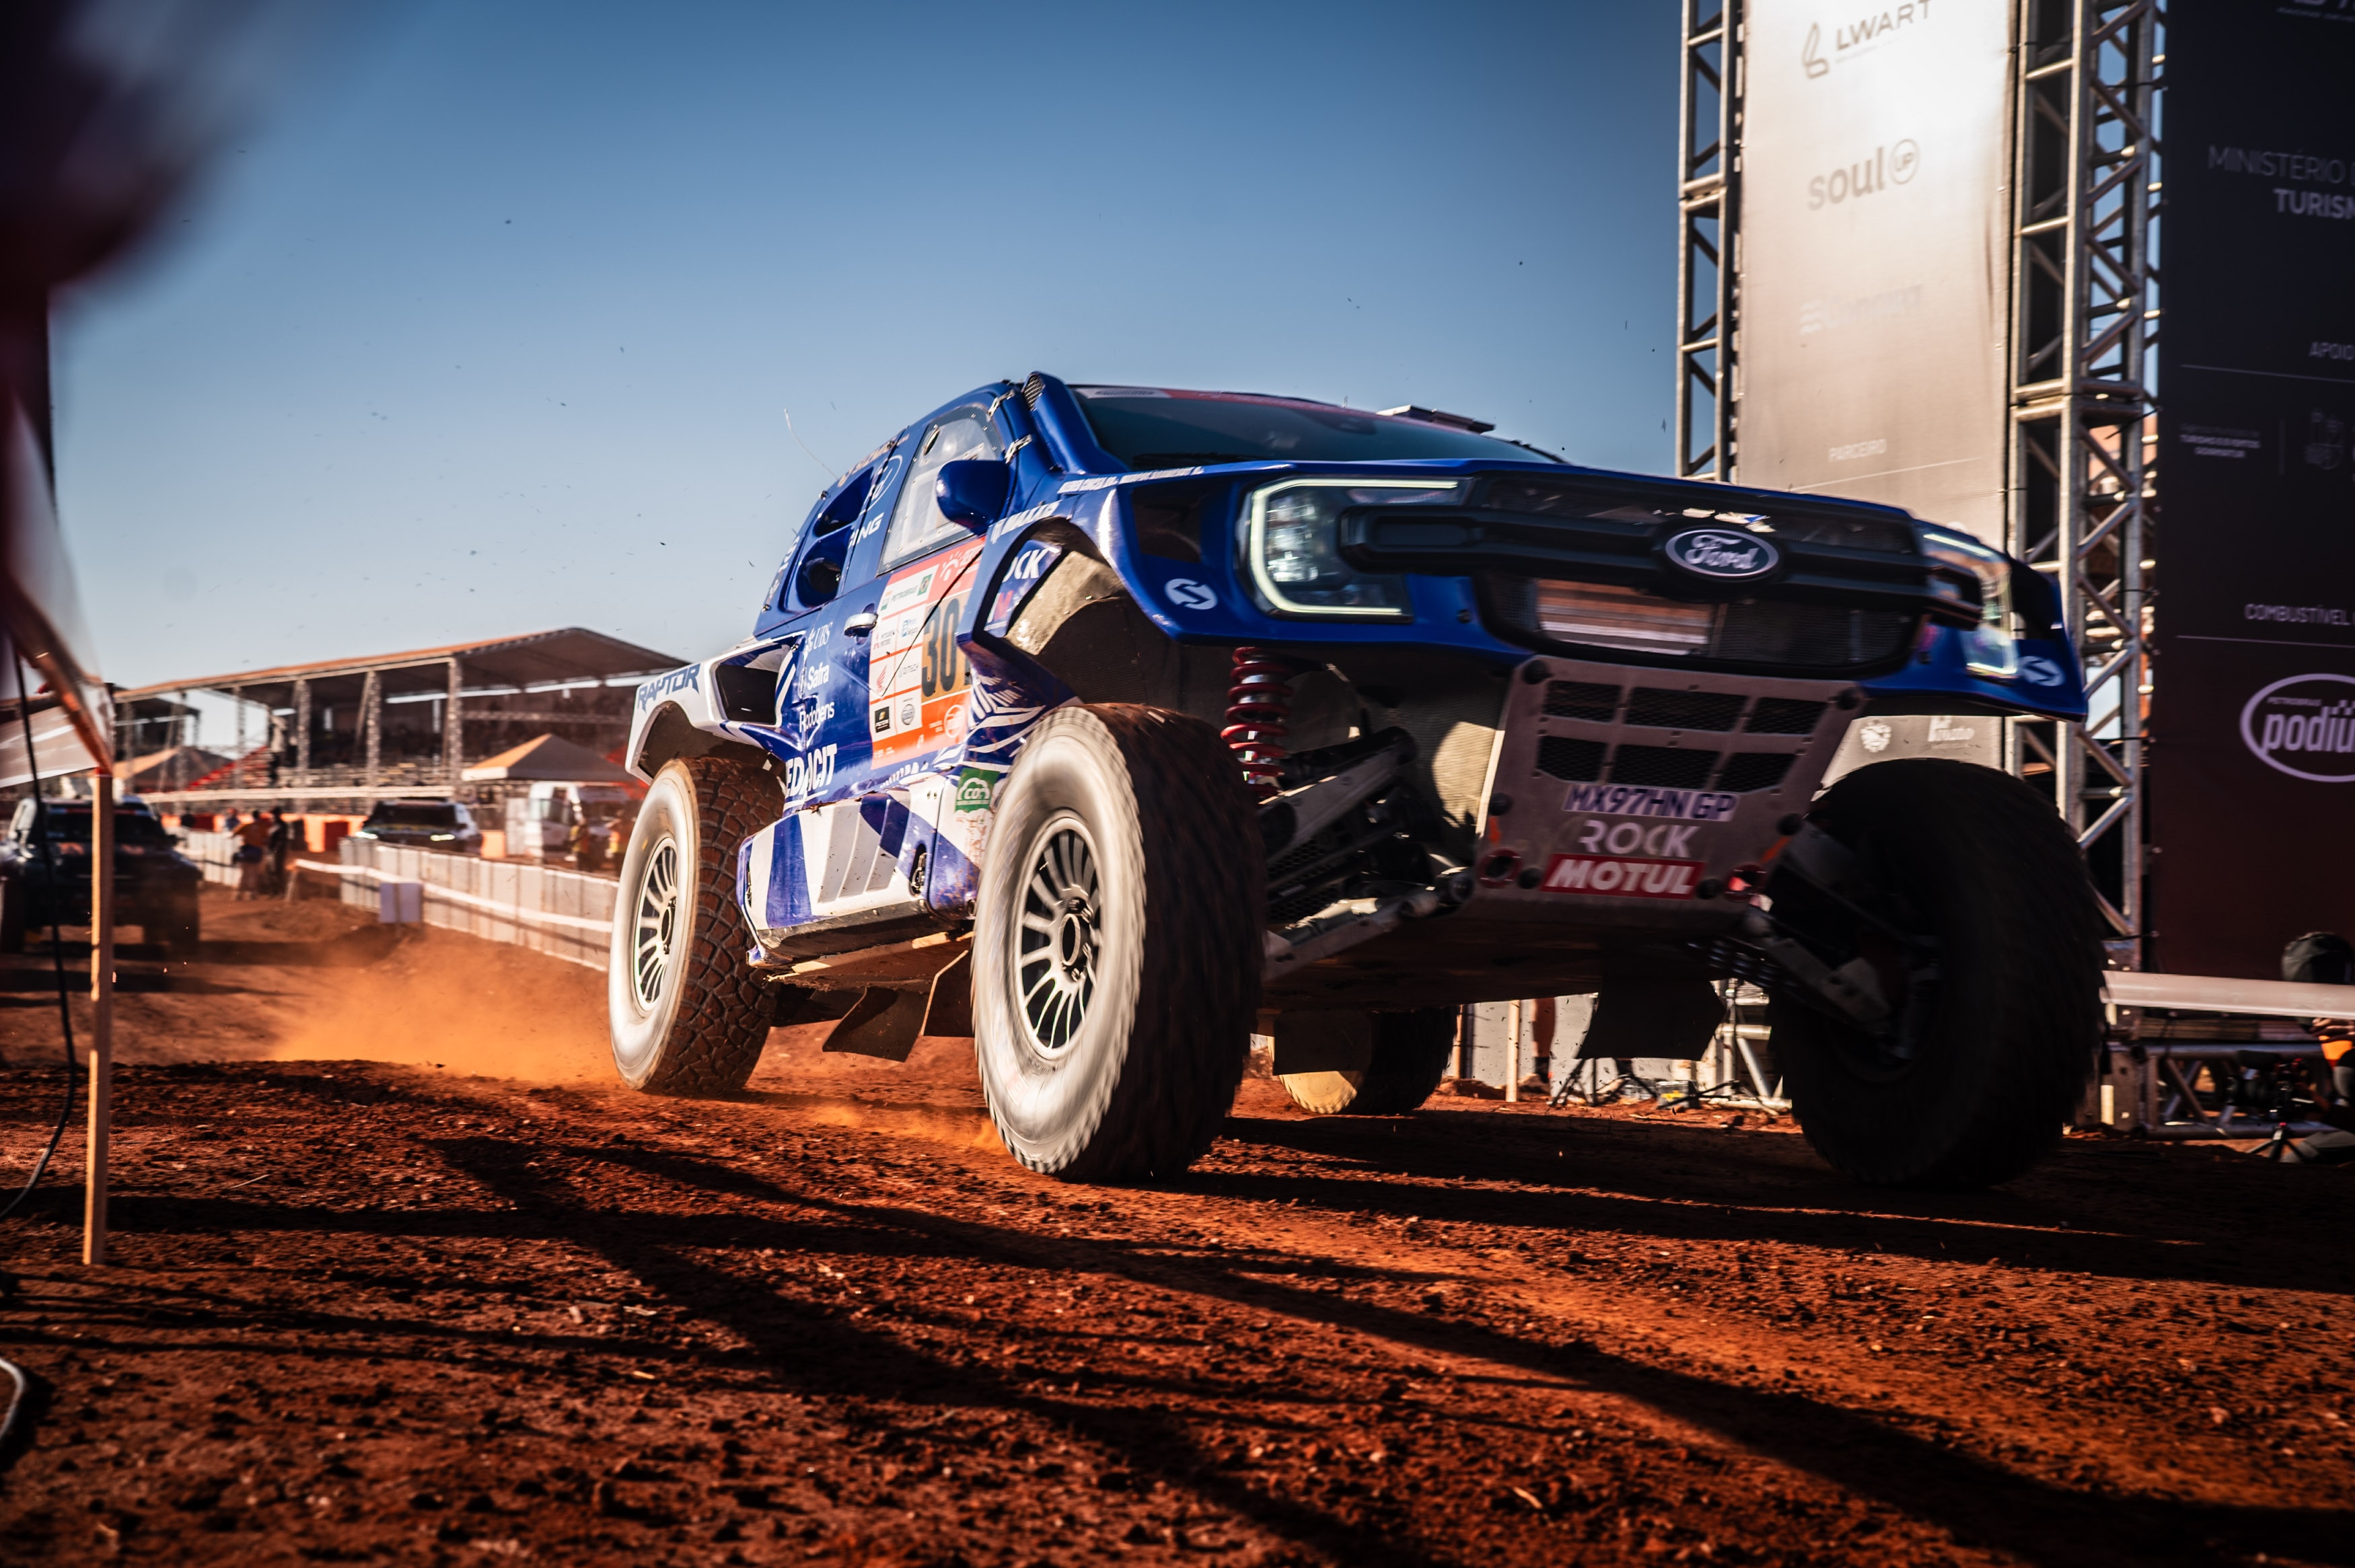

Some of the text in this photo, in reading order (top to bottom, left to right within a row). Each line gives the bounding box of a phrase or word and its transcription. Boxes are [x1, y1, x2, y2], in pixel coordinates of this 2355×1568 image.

[1836, 0, 1931, 52] LWART
[1807, 145, 1885, 211] soul
[2208, 144, 2346, 184] MINISTÉRIO
[1827, 439, 1887, 463] PARCEIRO
[1685, 534, 1760, 570] Ford
[637, 663, 701, 716] RAPTOR
[807, 661, 830, 691] Safra
[1578, 819, 1702, 858] ROCK
[1545, 859, 1696, 895] MOTUL
